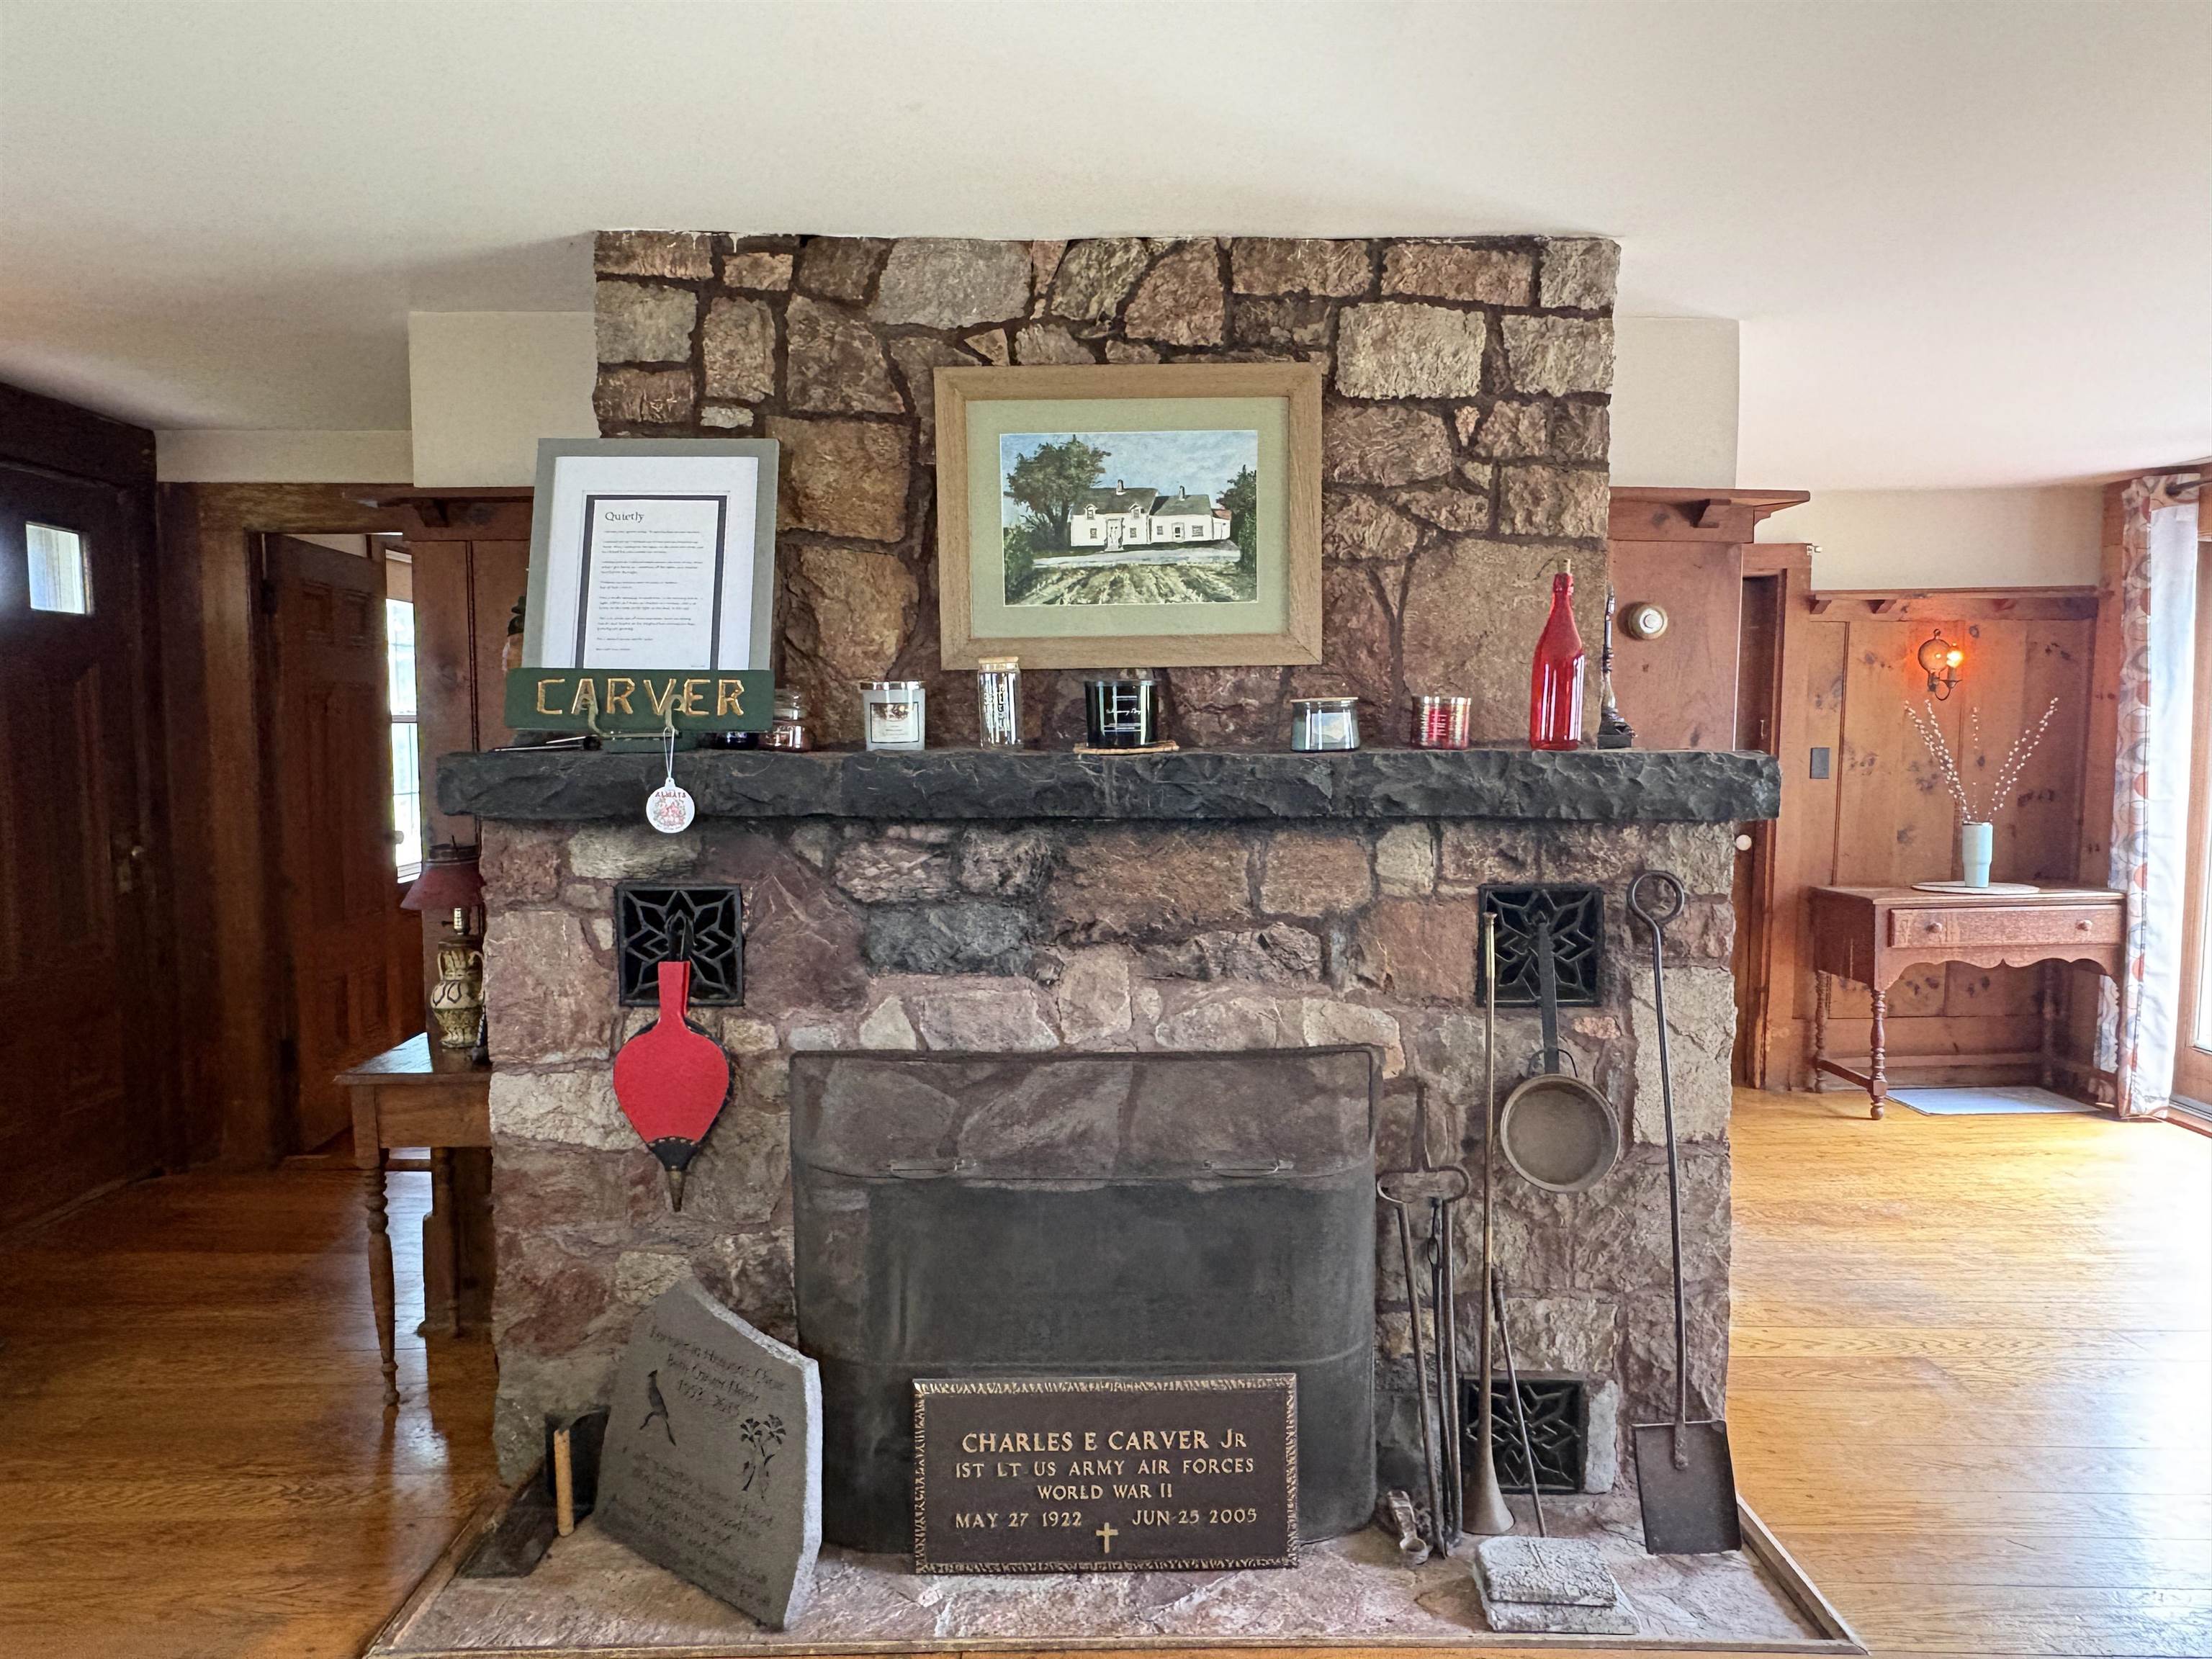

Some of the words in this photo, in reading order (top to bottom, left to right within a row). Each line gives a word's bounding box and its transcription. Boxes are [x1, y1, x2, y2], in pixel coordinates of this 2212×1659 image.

[605, 511, 644, 523] Quietly
[536, 678, 745, 716] CARVER
[962, 1431, 1073, 1453] CHARLES
[1084, 1431, 1097, 1451] E
[1108, 1429, 1209, 1451] CARVER
[997, 1462, 1022, 1477] LT
[1034, 1461, 1056, 1477] US
[1069, 1460, 1125, 1476] ARMY
[1138, 1459, 1170, 1475] AIR
[1183, 1457, 1254, 1474] FORCES
[1037, 1485, 1103, 1501] WORLD
[1112, 1484, 1152, 1499] WAR
[1160, 1483, 1172, 1498] II
[956, 1513, 999, 1528] MAY
[1008, 1511, 1029, 1527] 27
[1043, 1511, 1082, 1527] 1922
[1132, 1509, 1170, 1527] JUN
[1178, 1509, 1200, 1524] 25
[1209, 1508, 1257, 1524] 2005
